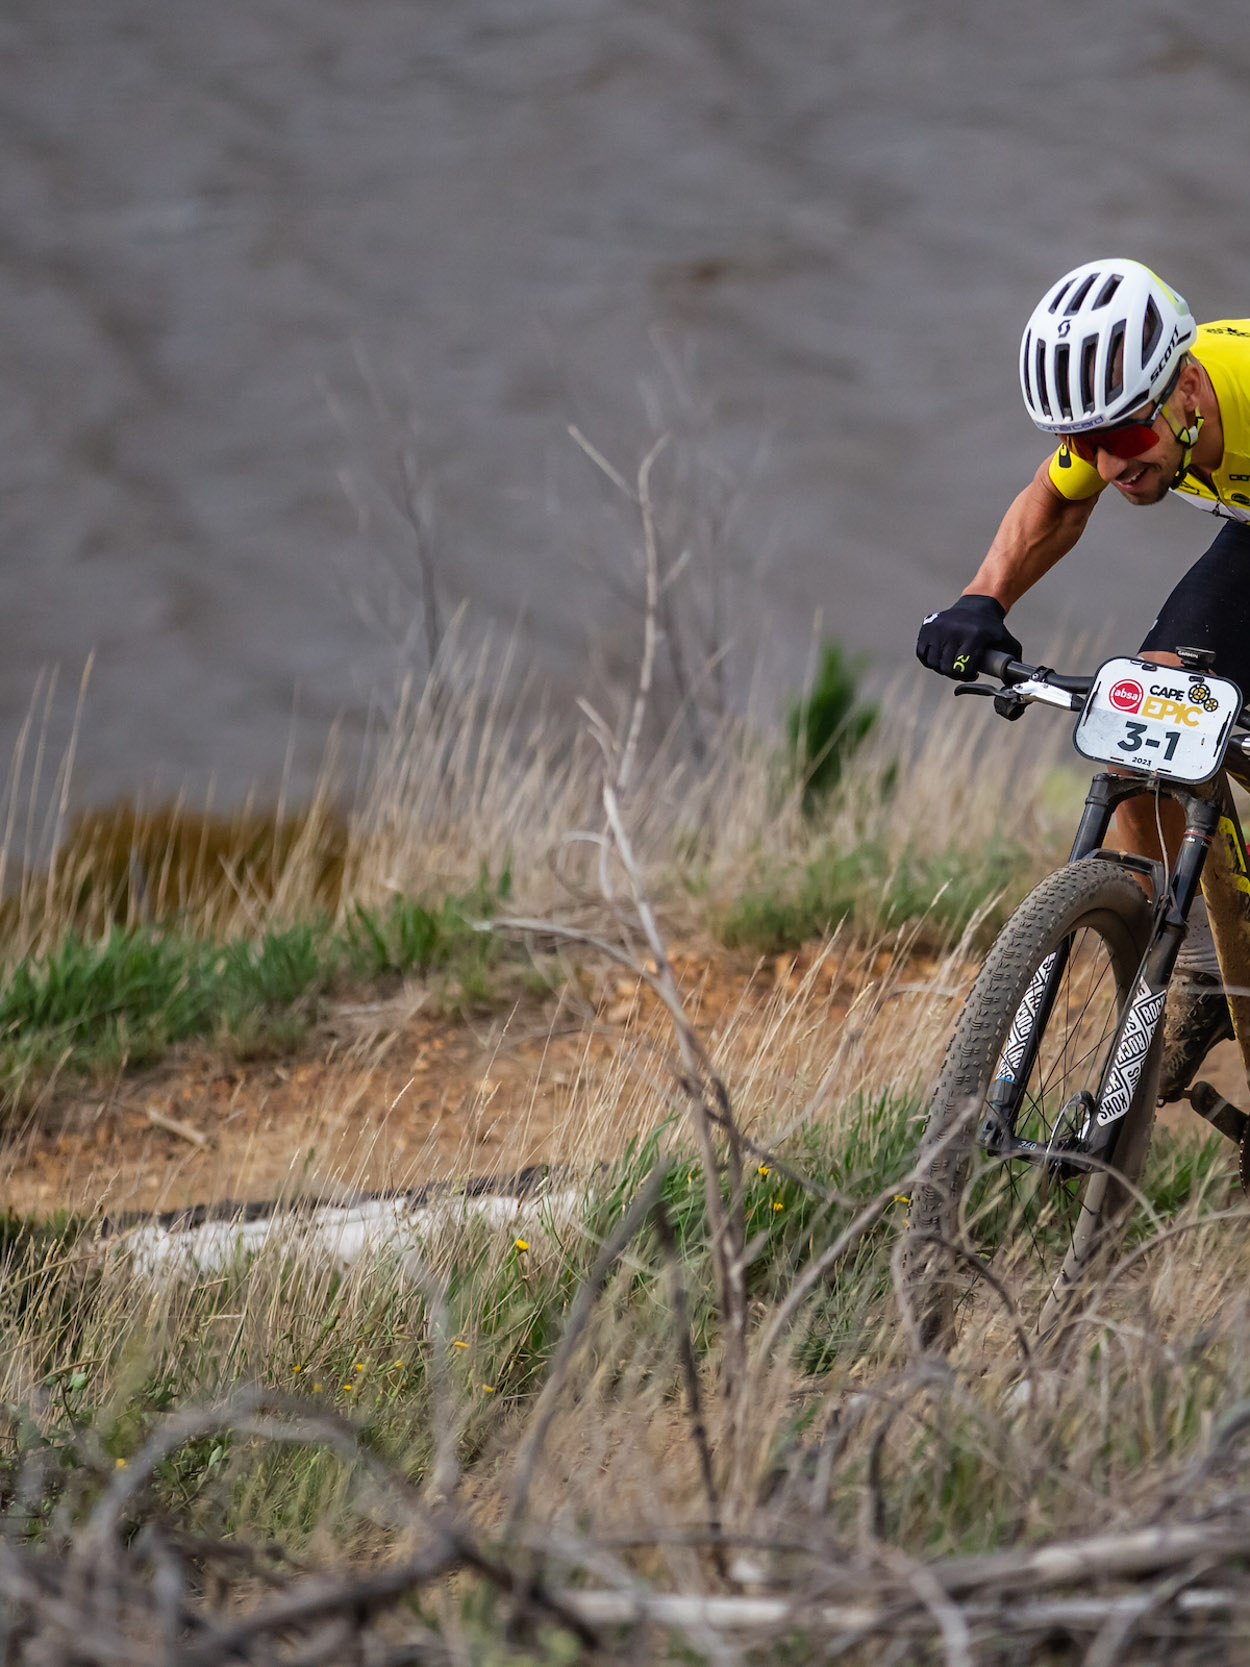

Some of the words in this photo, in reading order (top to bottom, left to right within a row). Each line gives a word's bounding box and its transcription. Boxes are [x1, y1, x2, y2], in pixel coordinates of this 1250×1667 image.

[1150, 324, 1179, 386] SCOTT
[1115, 687, 1139, 700] absa
[1149, 684, 1185, 702] CAPE
[1141, 696, 1203, 727] EPIC
[1117, 720, 1182, 761] 3-1
[1099, 1091, 1128, 1120] SHOX
